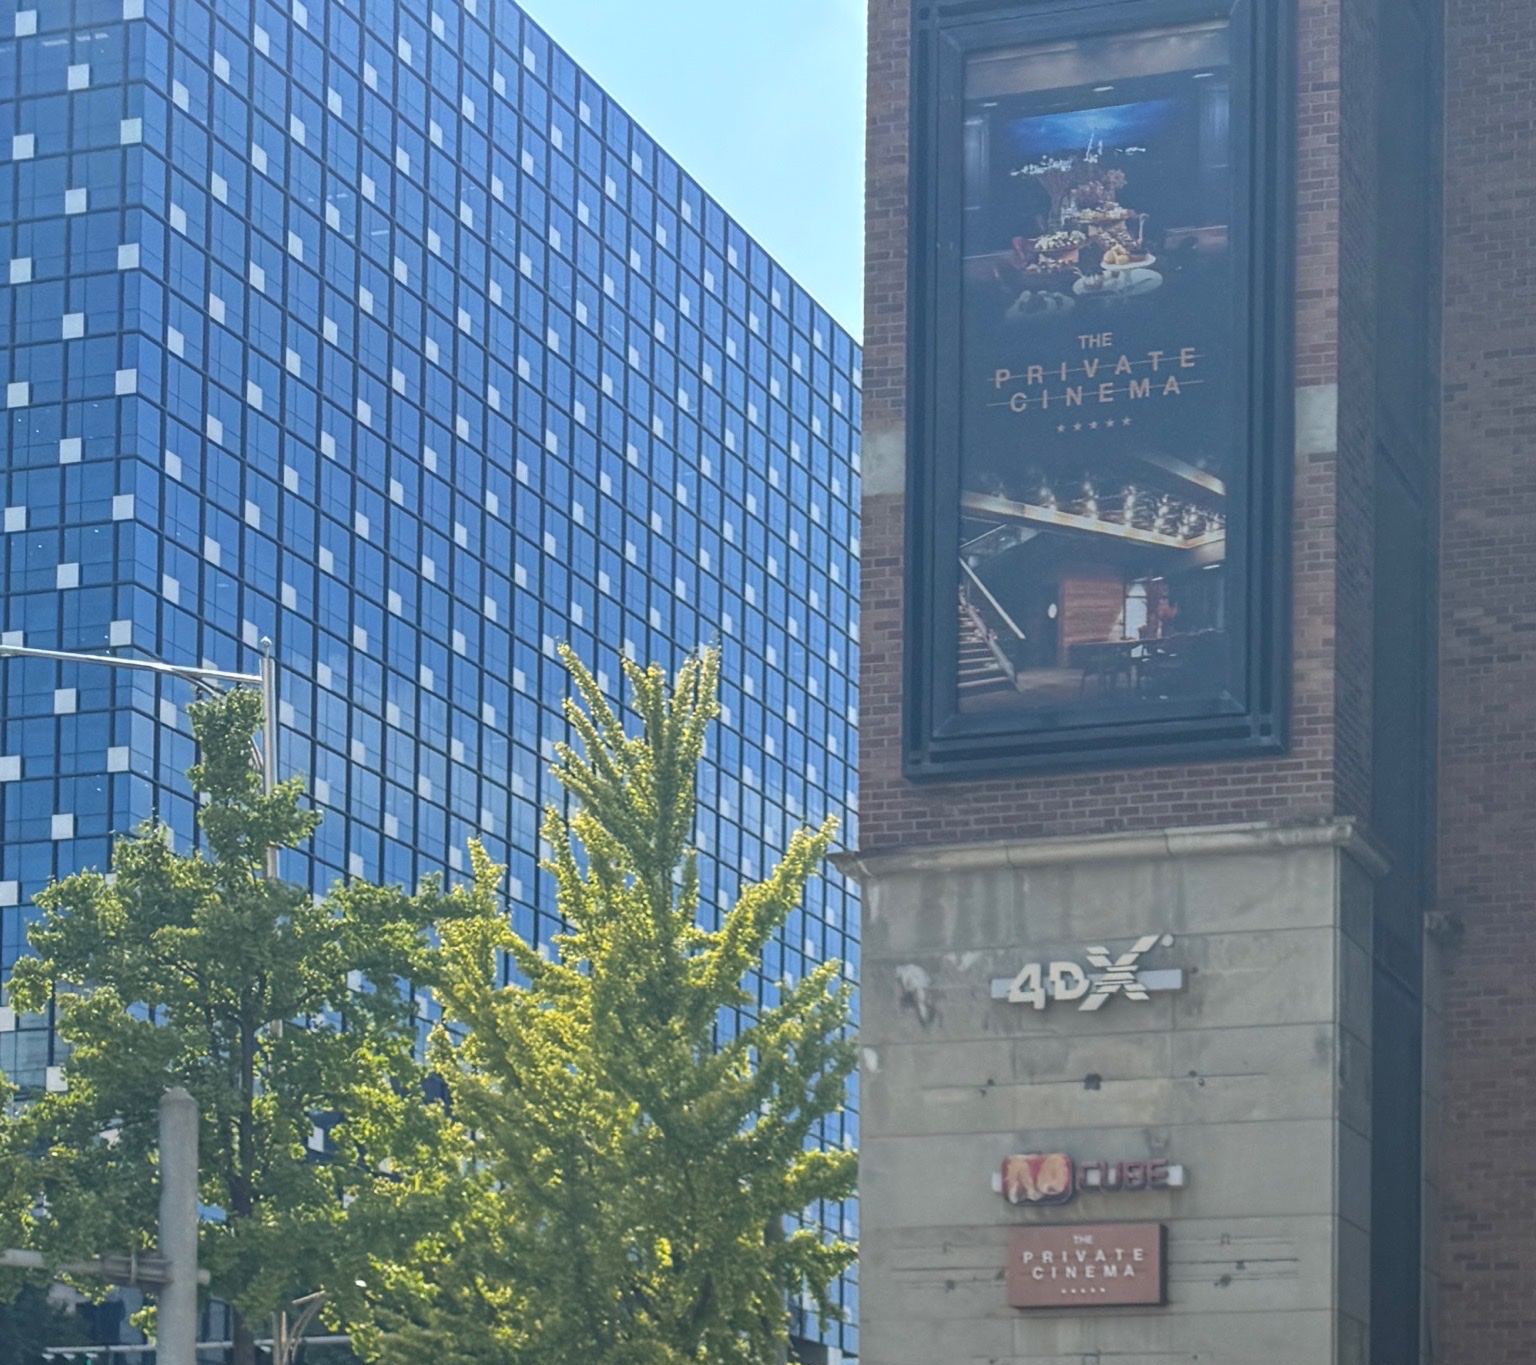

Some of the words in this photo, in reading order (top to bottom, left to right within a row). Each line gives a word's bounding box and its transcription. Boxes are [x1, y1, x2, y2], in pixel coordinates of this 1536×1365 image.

[1078, 332, 1113, 349] THE
[995, 347, 1195, 389] PRIVATE
[1009, 375, 1181, 412] CINEMA
[1008, 935, 1161, 1011] 4DX
[1077, 1158, 1169, 1191] CUBE
[1072, 1234, 1094, 1245] THE
[1022, 1247, 1145, 1264] PRIVATE
[1031, 1264, 1136, 1280] CINEMA
